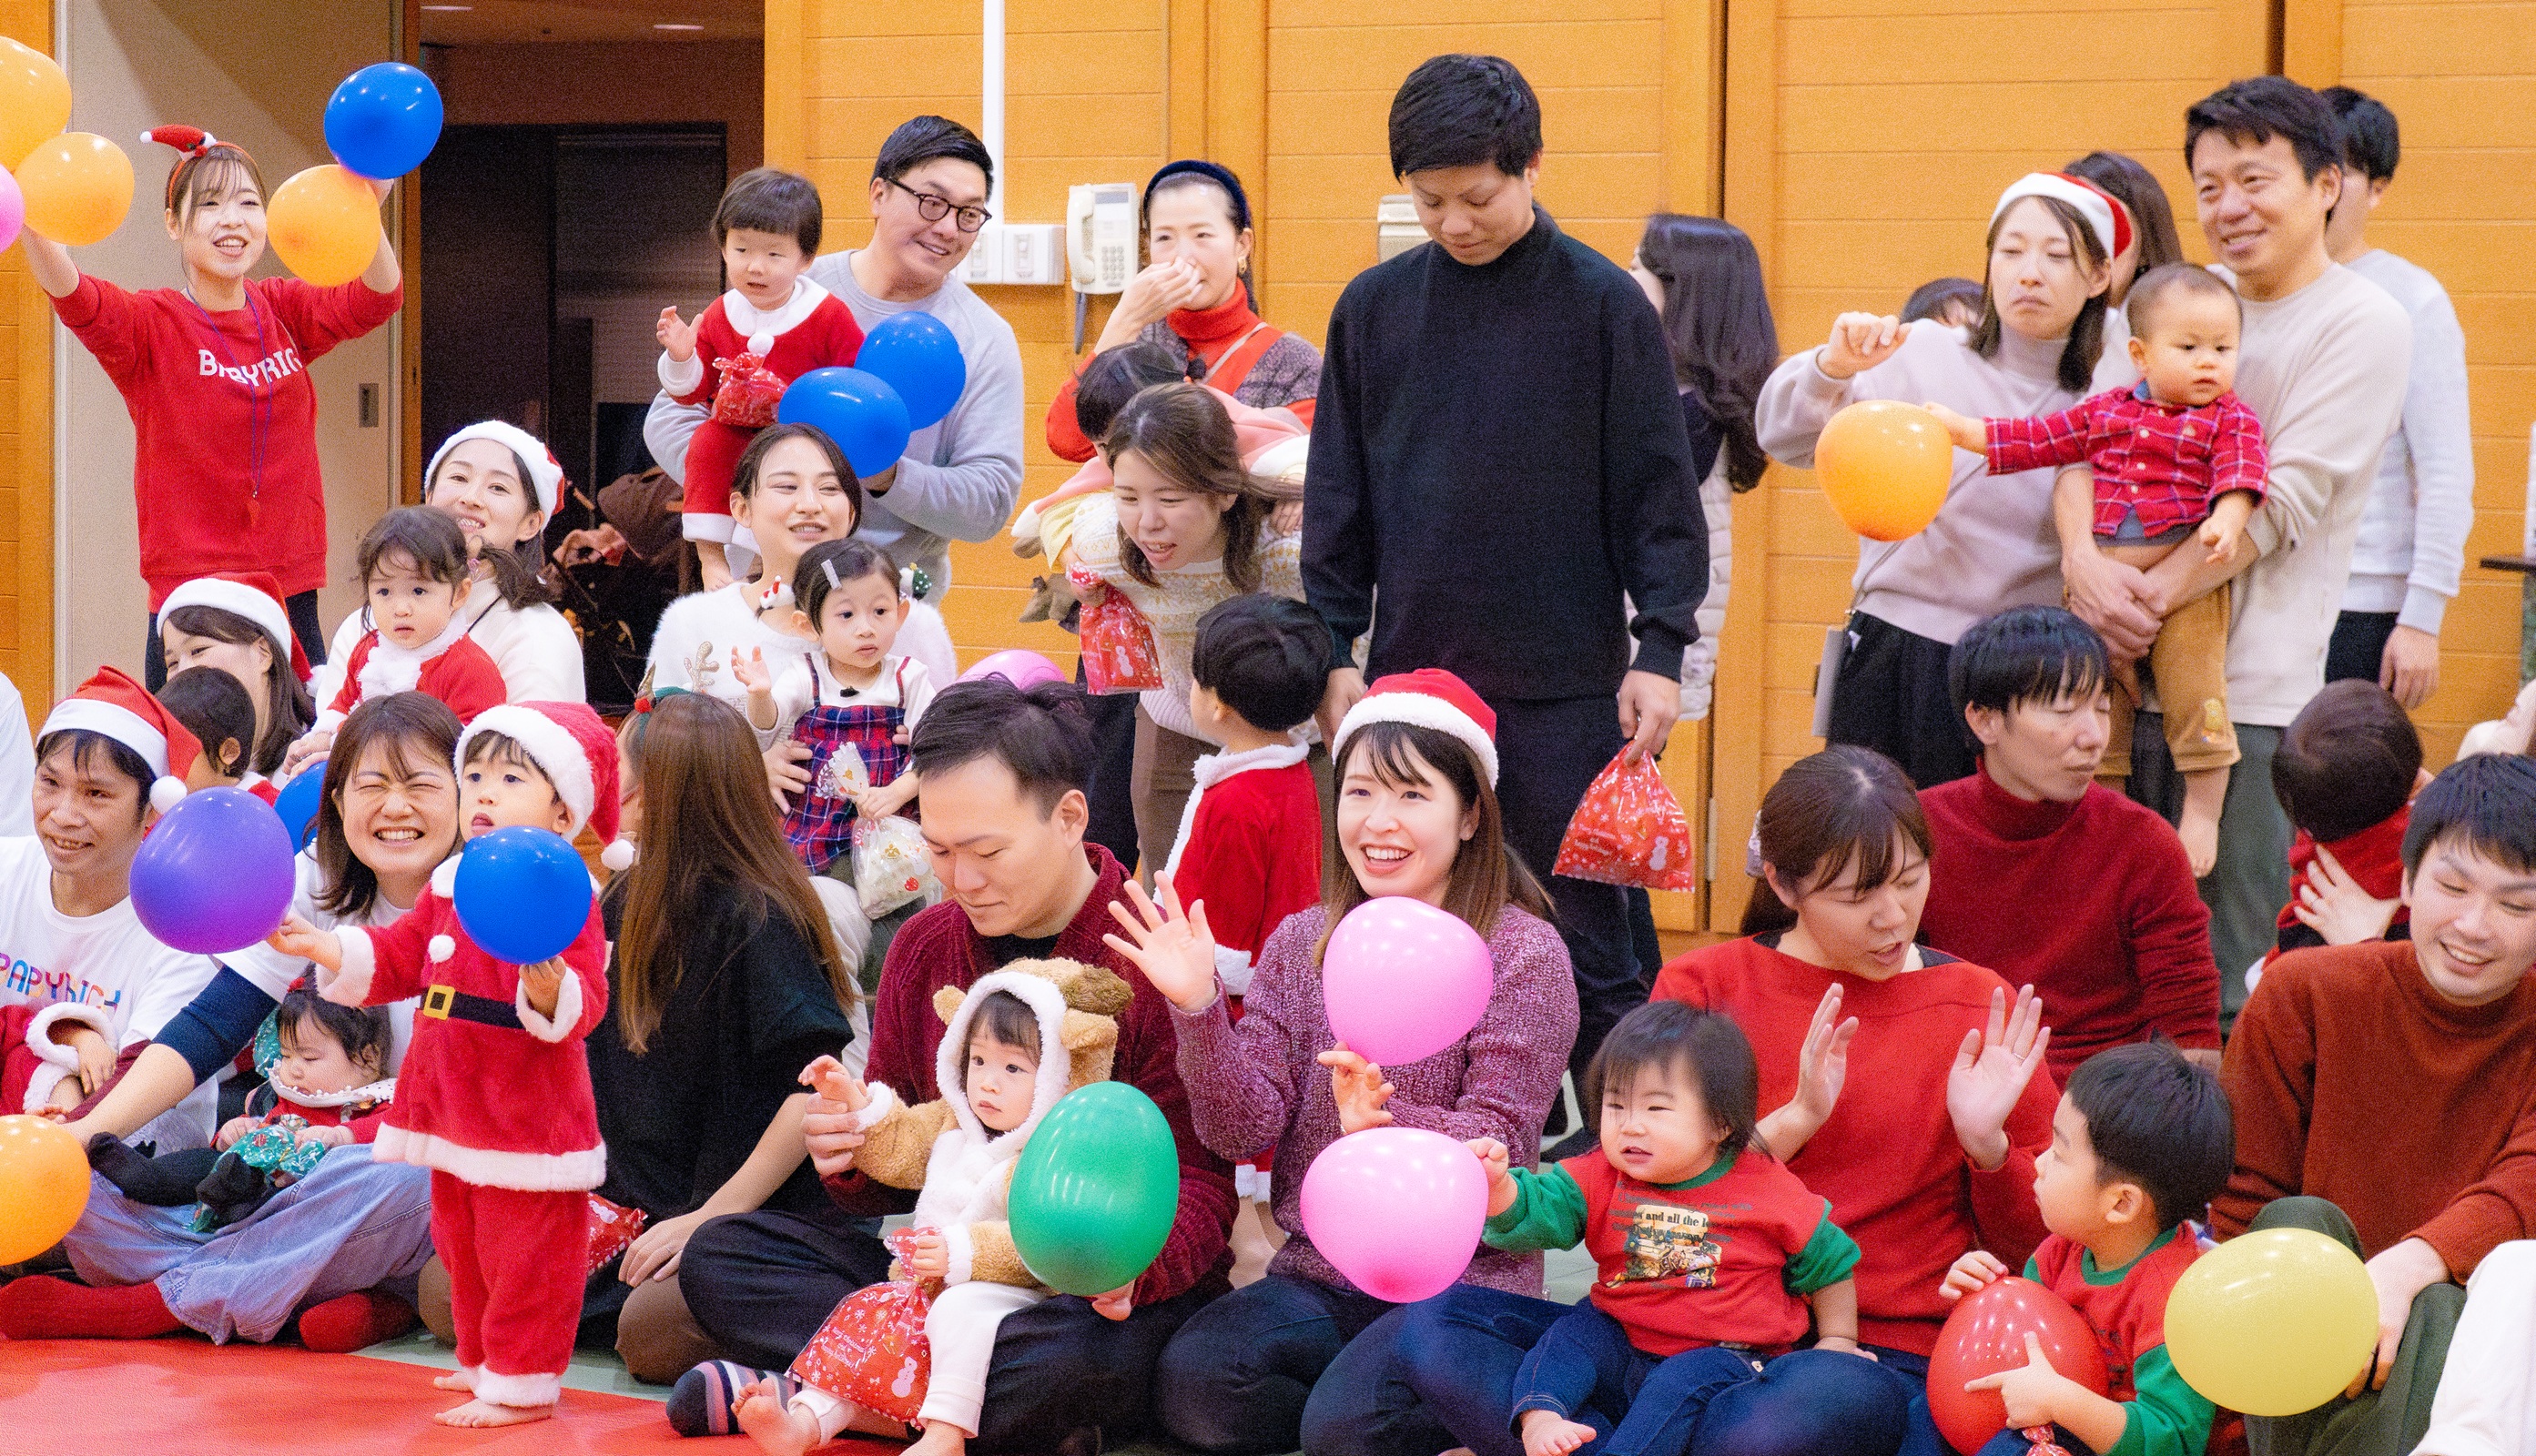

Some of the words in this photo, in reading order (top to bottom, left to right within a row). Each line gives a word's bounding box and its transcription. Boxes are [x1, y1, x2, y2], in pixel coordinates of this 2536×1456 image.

[1645, 1211, 1665, 1222] and
[1667, 1213, 1681, 1225] all
[1683, 1215, 1699, 1227] the
